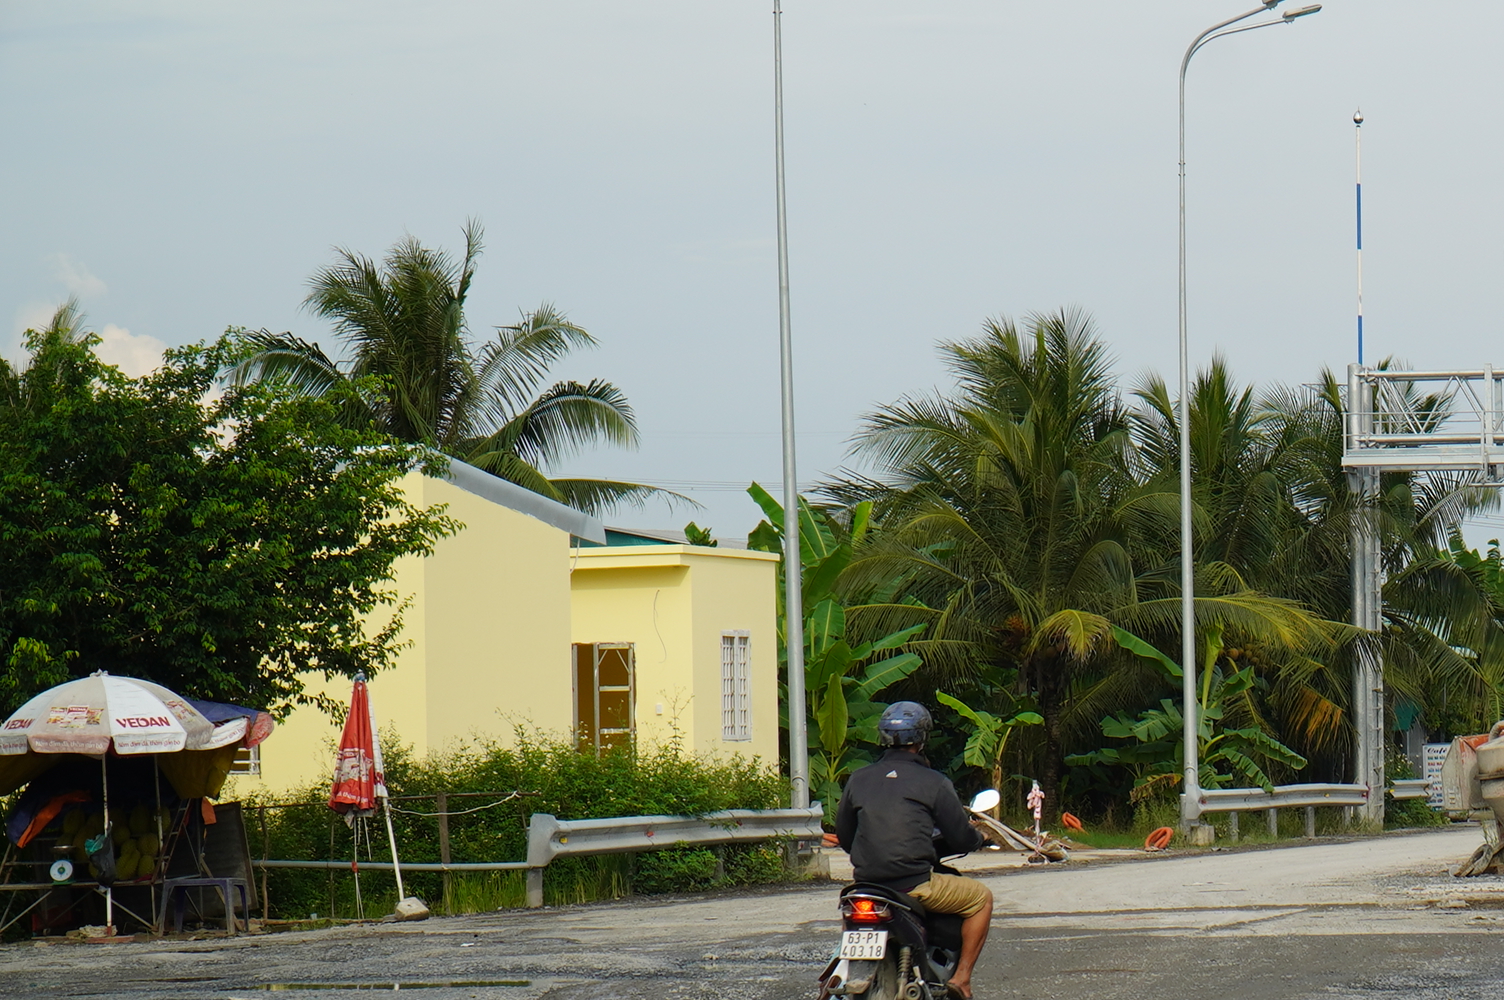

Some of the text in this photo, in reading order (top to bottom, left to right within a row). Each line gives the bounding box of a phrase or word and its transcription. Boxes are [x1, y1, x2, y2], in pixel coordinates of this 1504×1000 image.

[116, 716, 171, 728] VEDAN
[848, 932, 879, 944] 63-P1
[842, 945, 882, 957] 403.18
